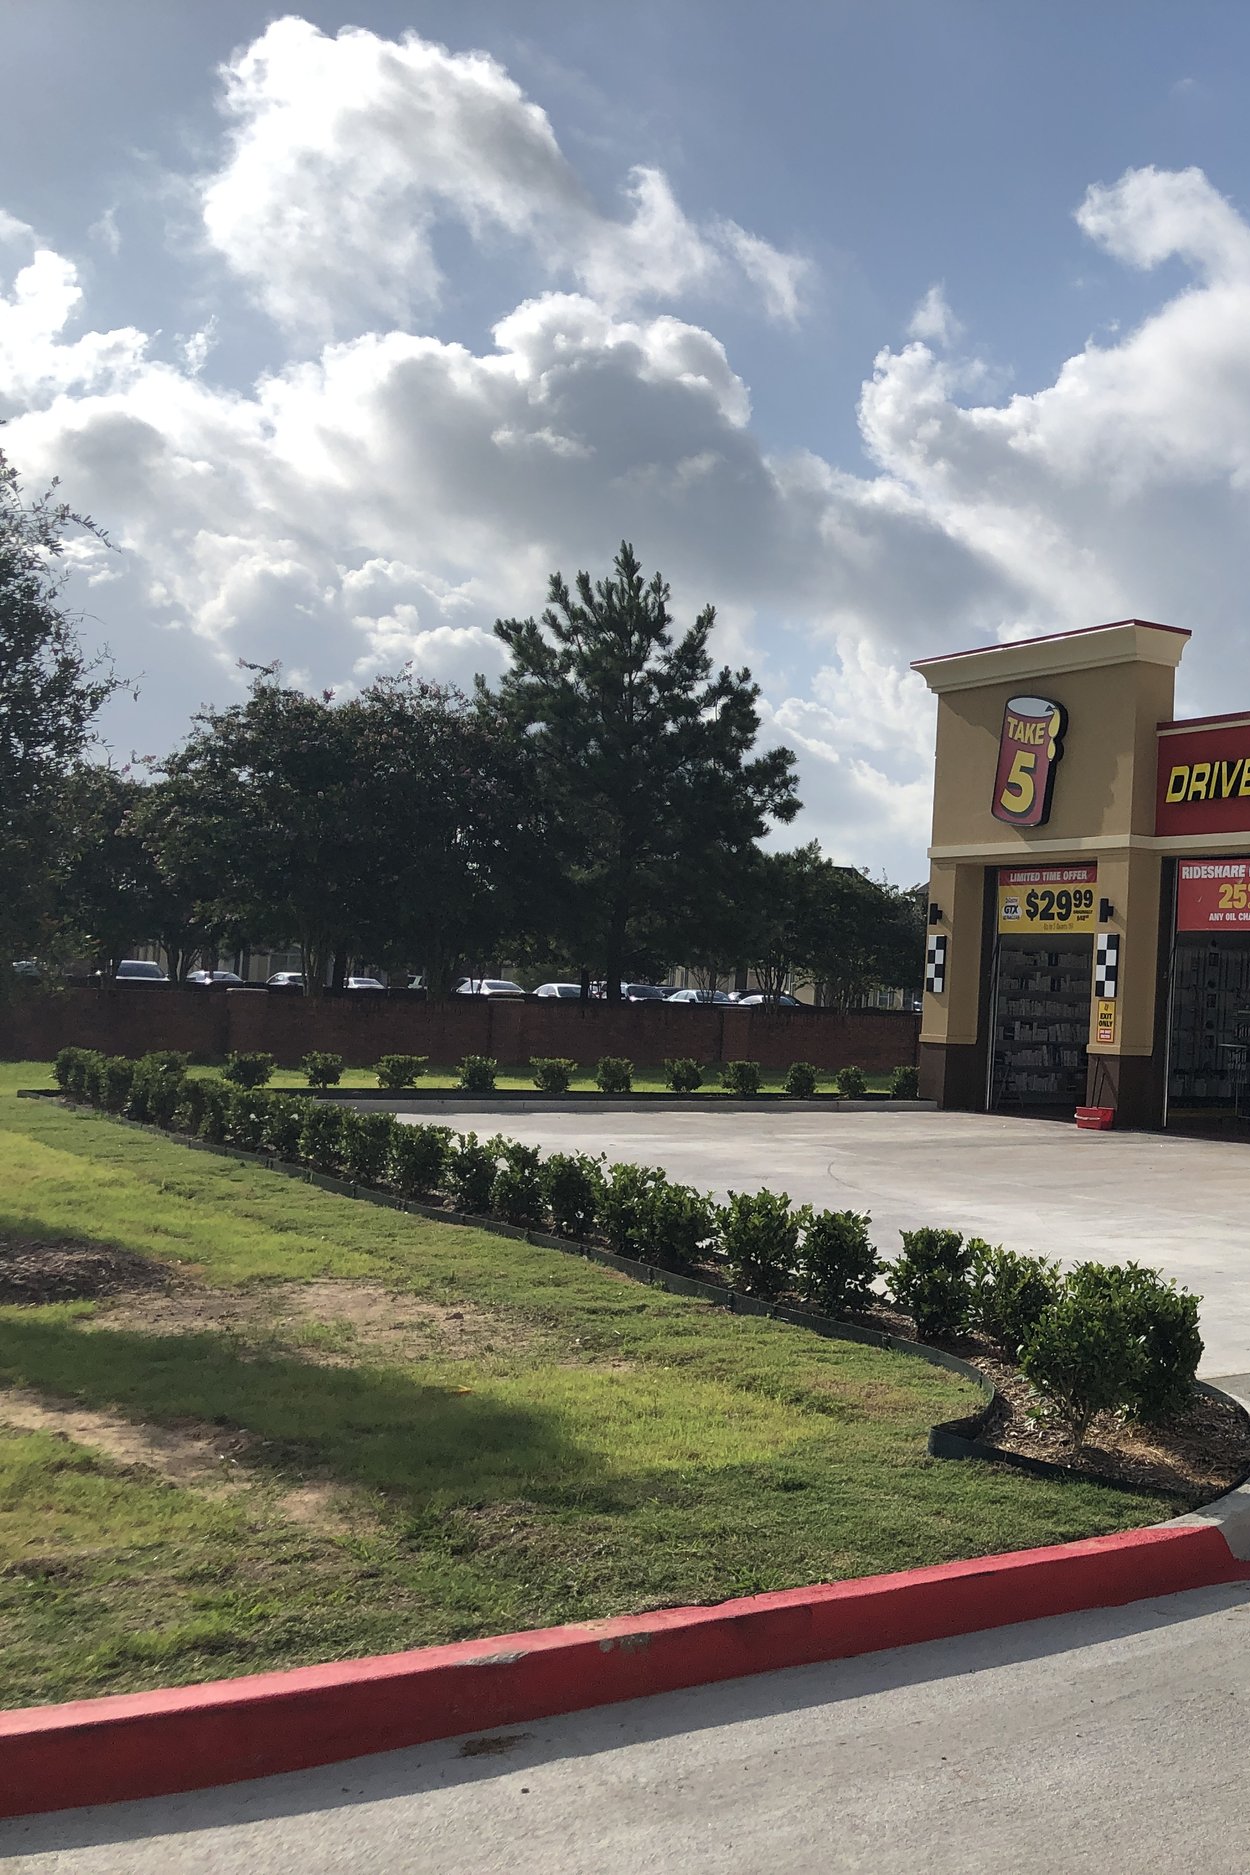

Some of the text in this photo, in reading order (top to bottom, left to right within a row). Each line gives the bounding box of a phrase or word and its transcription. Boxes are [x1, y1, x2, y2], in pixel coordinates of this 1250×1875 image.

[1007, 716, 1046, 745] TAKE
[1000, 749, 1036, 816] 5
[1010, 870, 1088, 882] LIMITED TIME OFFER
[1182, 864, 1246, 879] RIDESHARE
[1004, 904, 1019, 915] GTX
[1209, 913, 1223, 921] ANY
[1225, 913, 1237, 921] OIL
